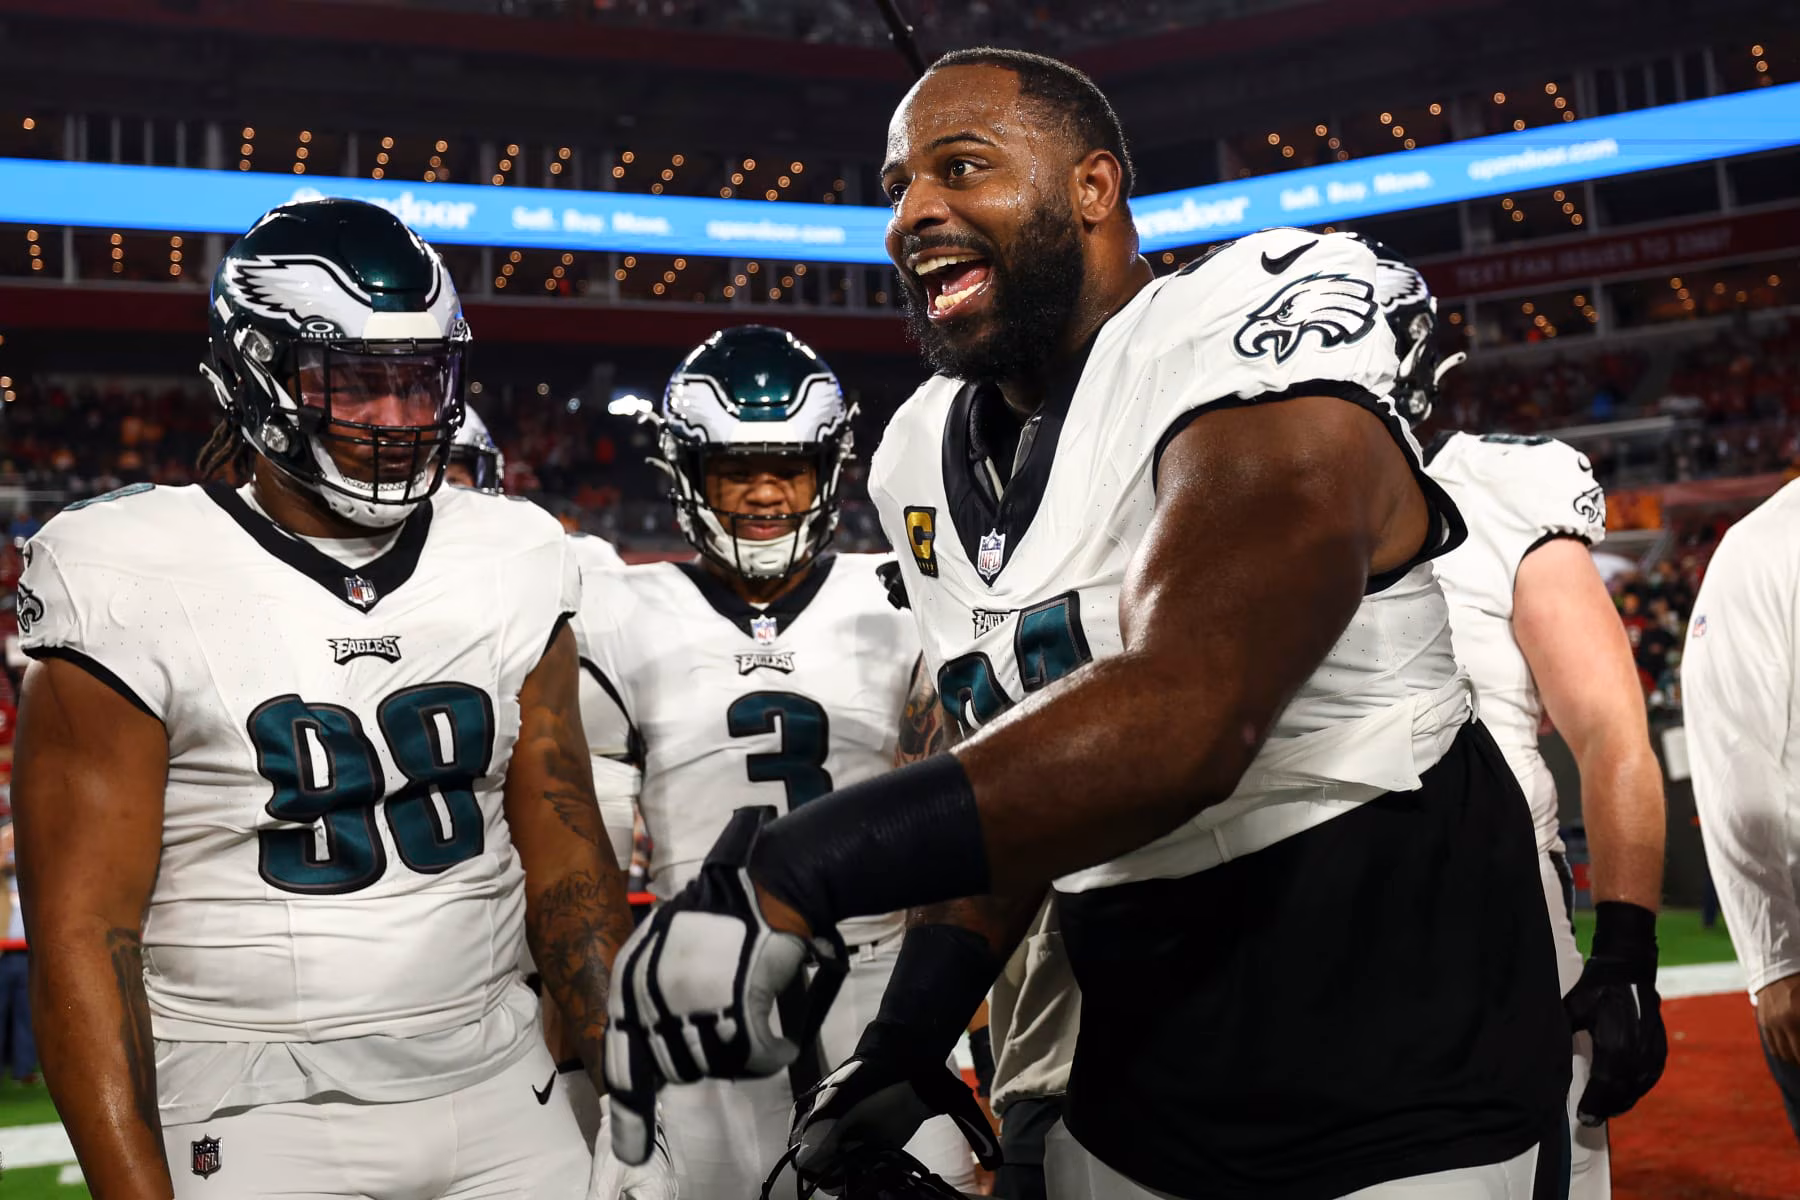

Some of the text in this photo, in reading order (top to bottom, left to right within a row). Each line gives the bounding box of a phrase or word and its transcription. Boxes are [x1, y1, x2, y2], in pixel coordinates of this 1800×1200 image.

[906, 511, 935, 560] C
[981, 551, 1001, 569] NFL
[326, 635, 402, 666] EAGLES
[727, 690, 834, 814] 3
[246, 681, 495, 895] 98
